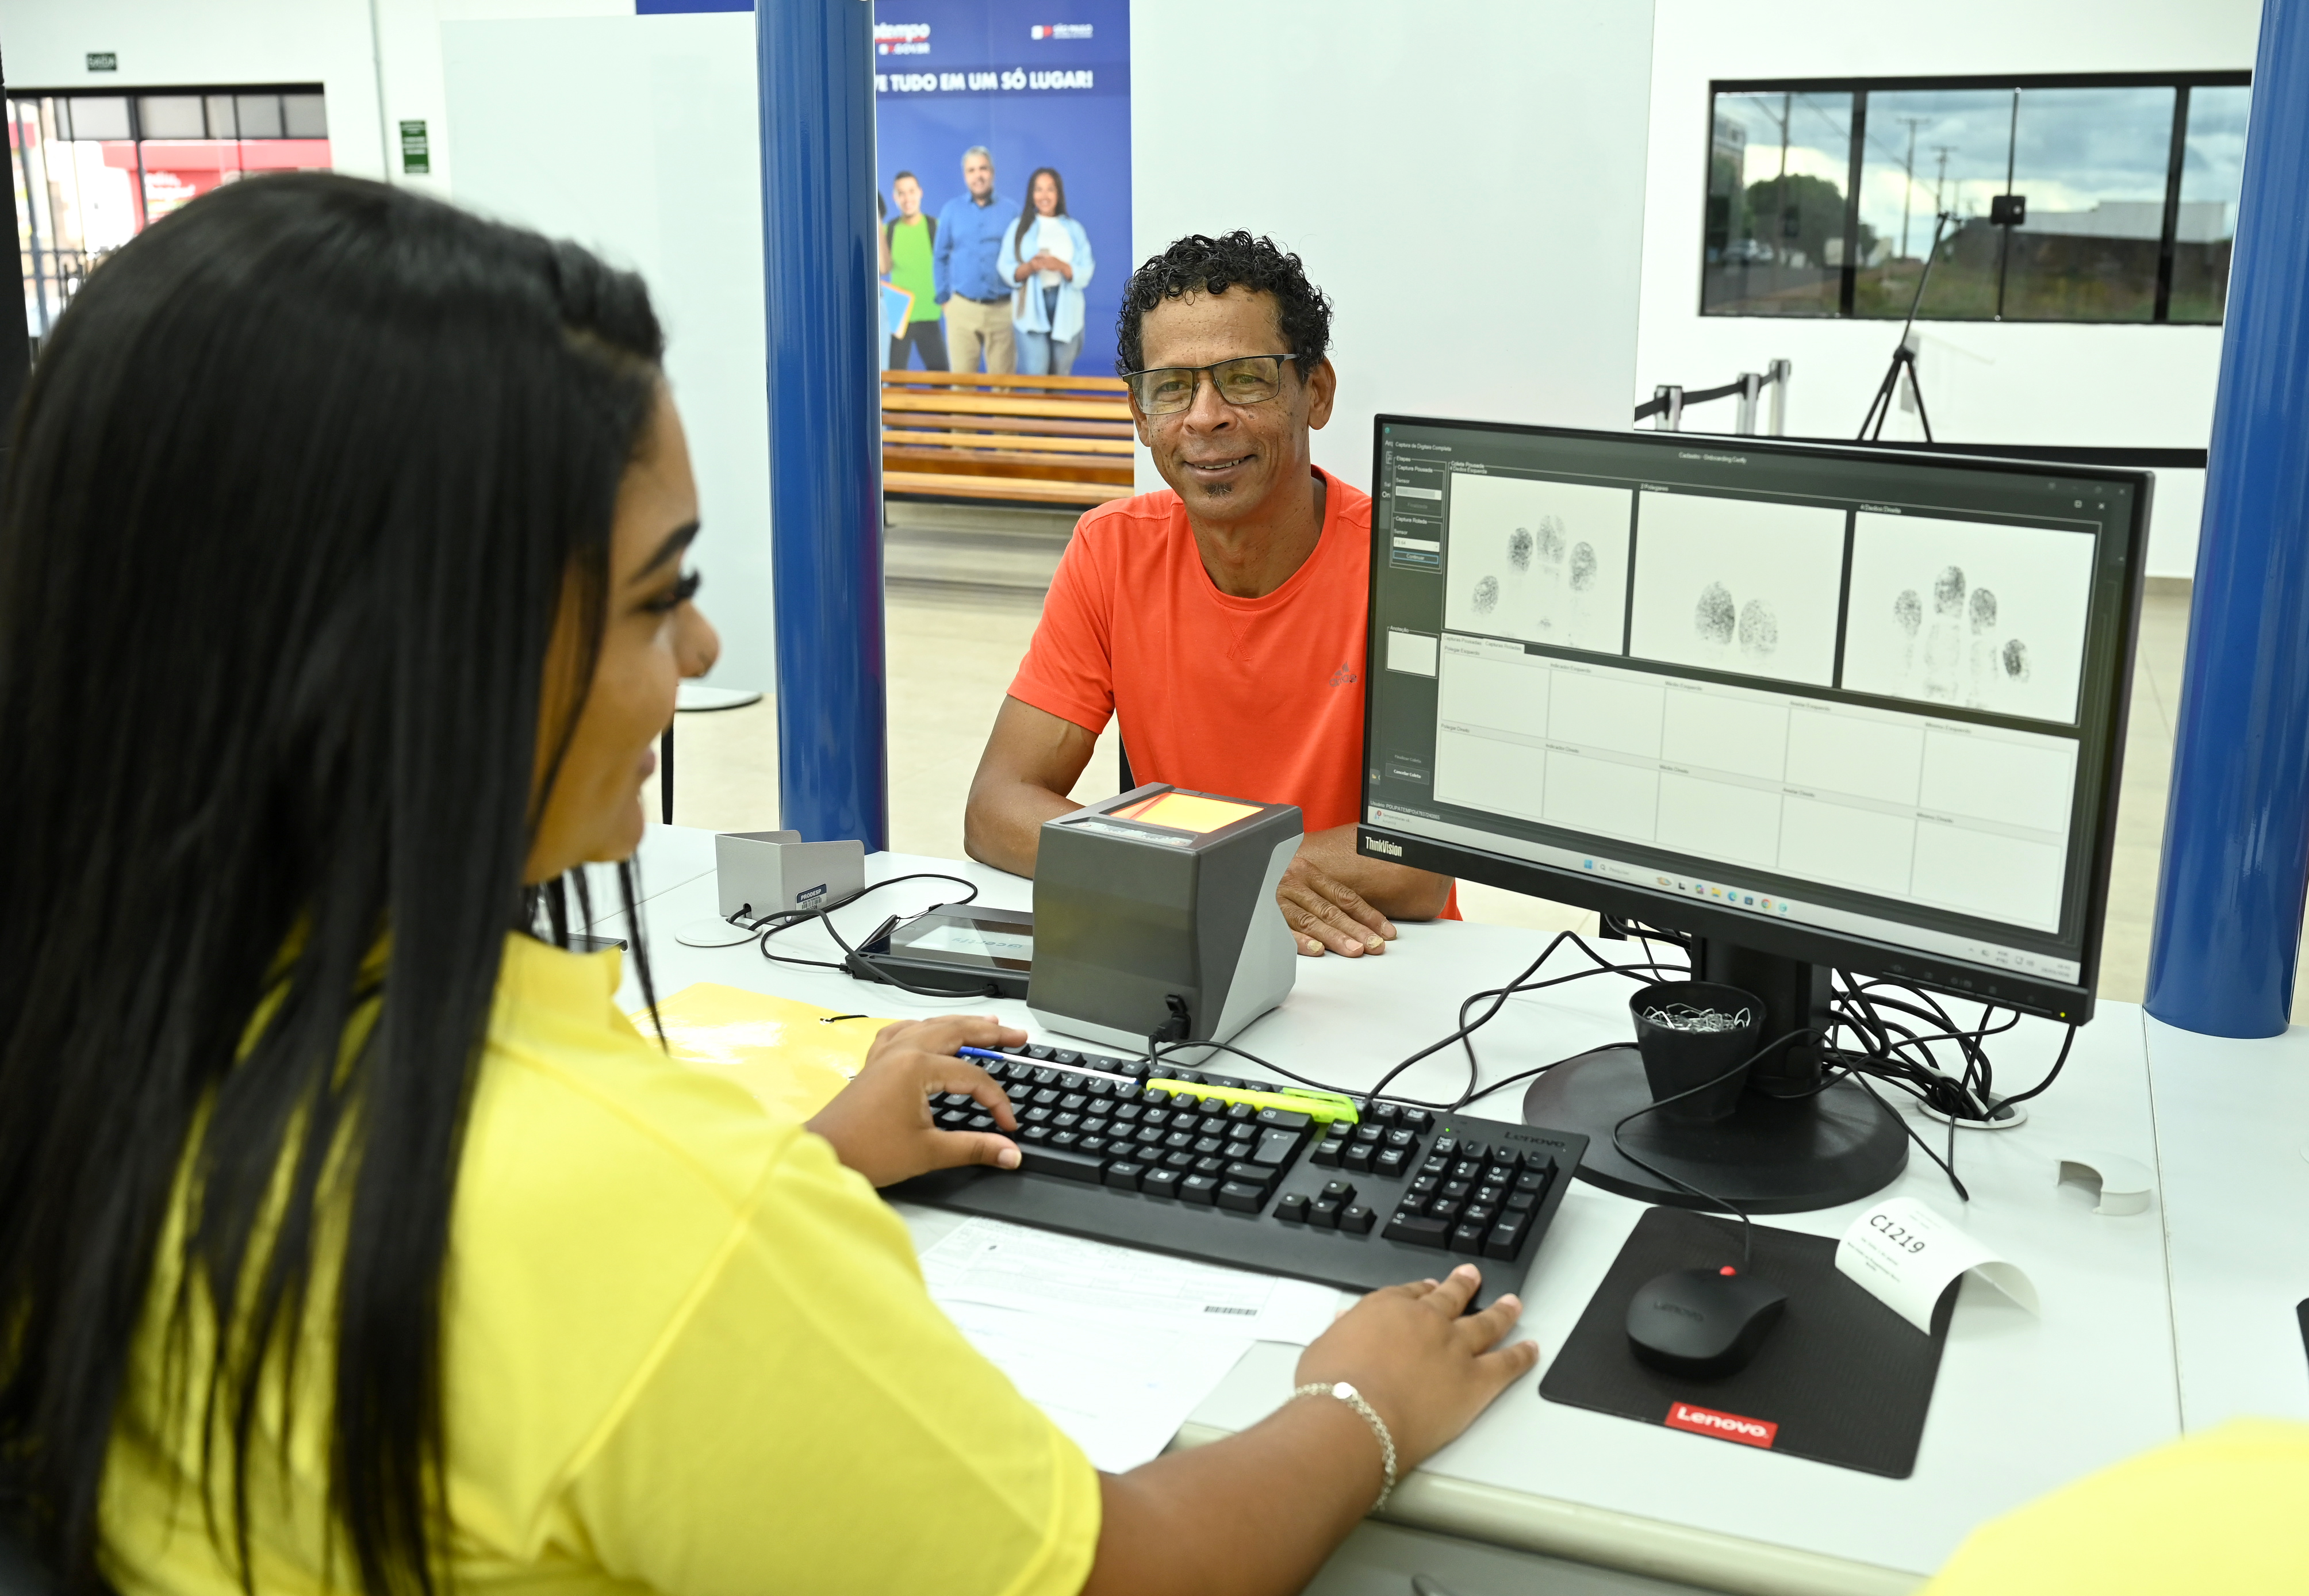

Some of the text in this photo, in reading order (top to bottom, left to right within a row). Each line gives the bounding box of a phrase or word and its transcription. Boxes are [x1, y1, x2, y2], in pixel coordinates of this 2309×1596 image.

[890, 74, 937, 91] TUDO
[939, 72, 966, 91] EM
[968, 72, 998, 90] UM
[1001, 67, 1027, 91] SÓ
[1029, 70, 1094, 90] LUGAR!
[1366, 836, 1402, 857] ThinkVision
[800, 889, 822, 901] PRODESP
[1504, 1131, 1565, 1148] Lenovo
[1870, 1215, 1925, 1253] C1219
[1677, 1406, 1767, 1437] Lenovo
